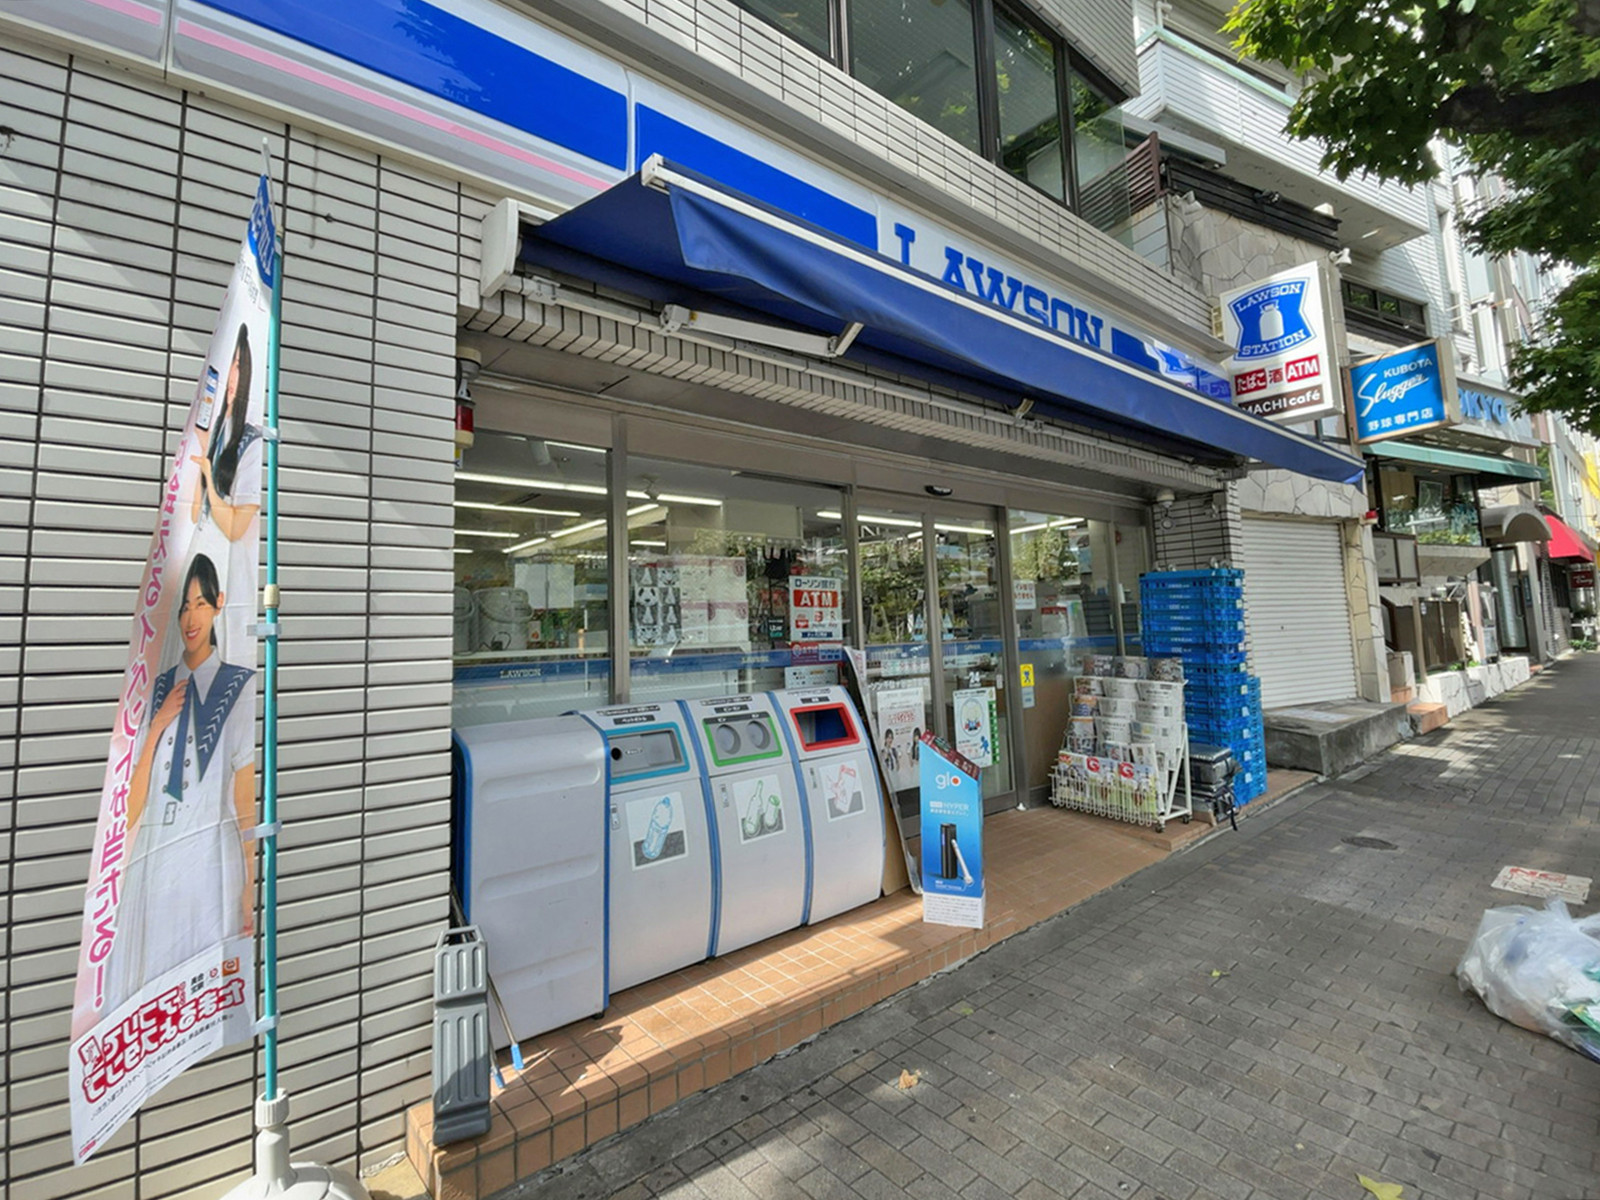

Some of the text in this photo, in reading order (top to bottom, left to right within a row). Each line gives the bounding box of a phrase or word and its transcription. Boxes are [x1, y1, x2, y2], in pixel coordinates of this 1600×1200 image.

[1236, 283, 1302, 312] LAWSON
[1241, 328, 1307, 356] STATION
[1236, 373, 1267, 393] たばこ
[1269, 368, 1284, 384] 酒
[1287, 359, 1319, 380] ATM
[1383, 358, 1434, 378] KUBOTA
[1242, 389, 1321, 415] MACHI café
[1357, 373, 1429, 417] Slugger
[1367, 408, 1434, 431] 野球専門店
[801, 592, 833, 607] ATM
[935, 772, 962, 790] glo
